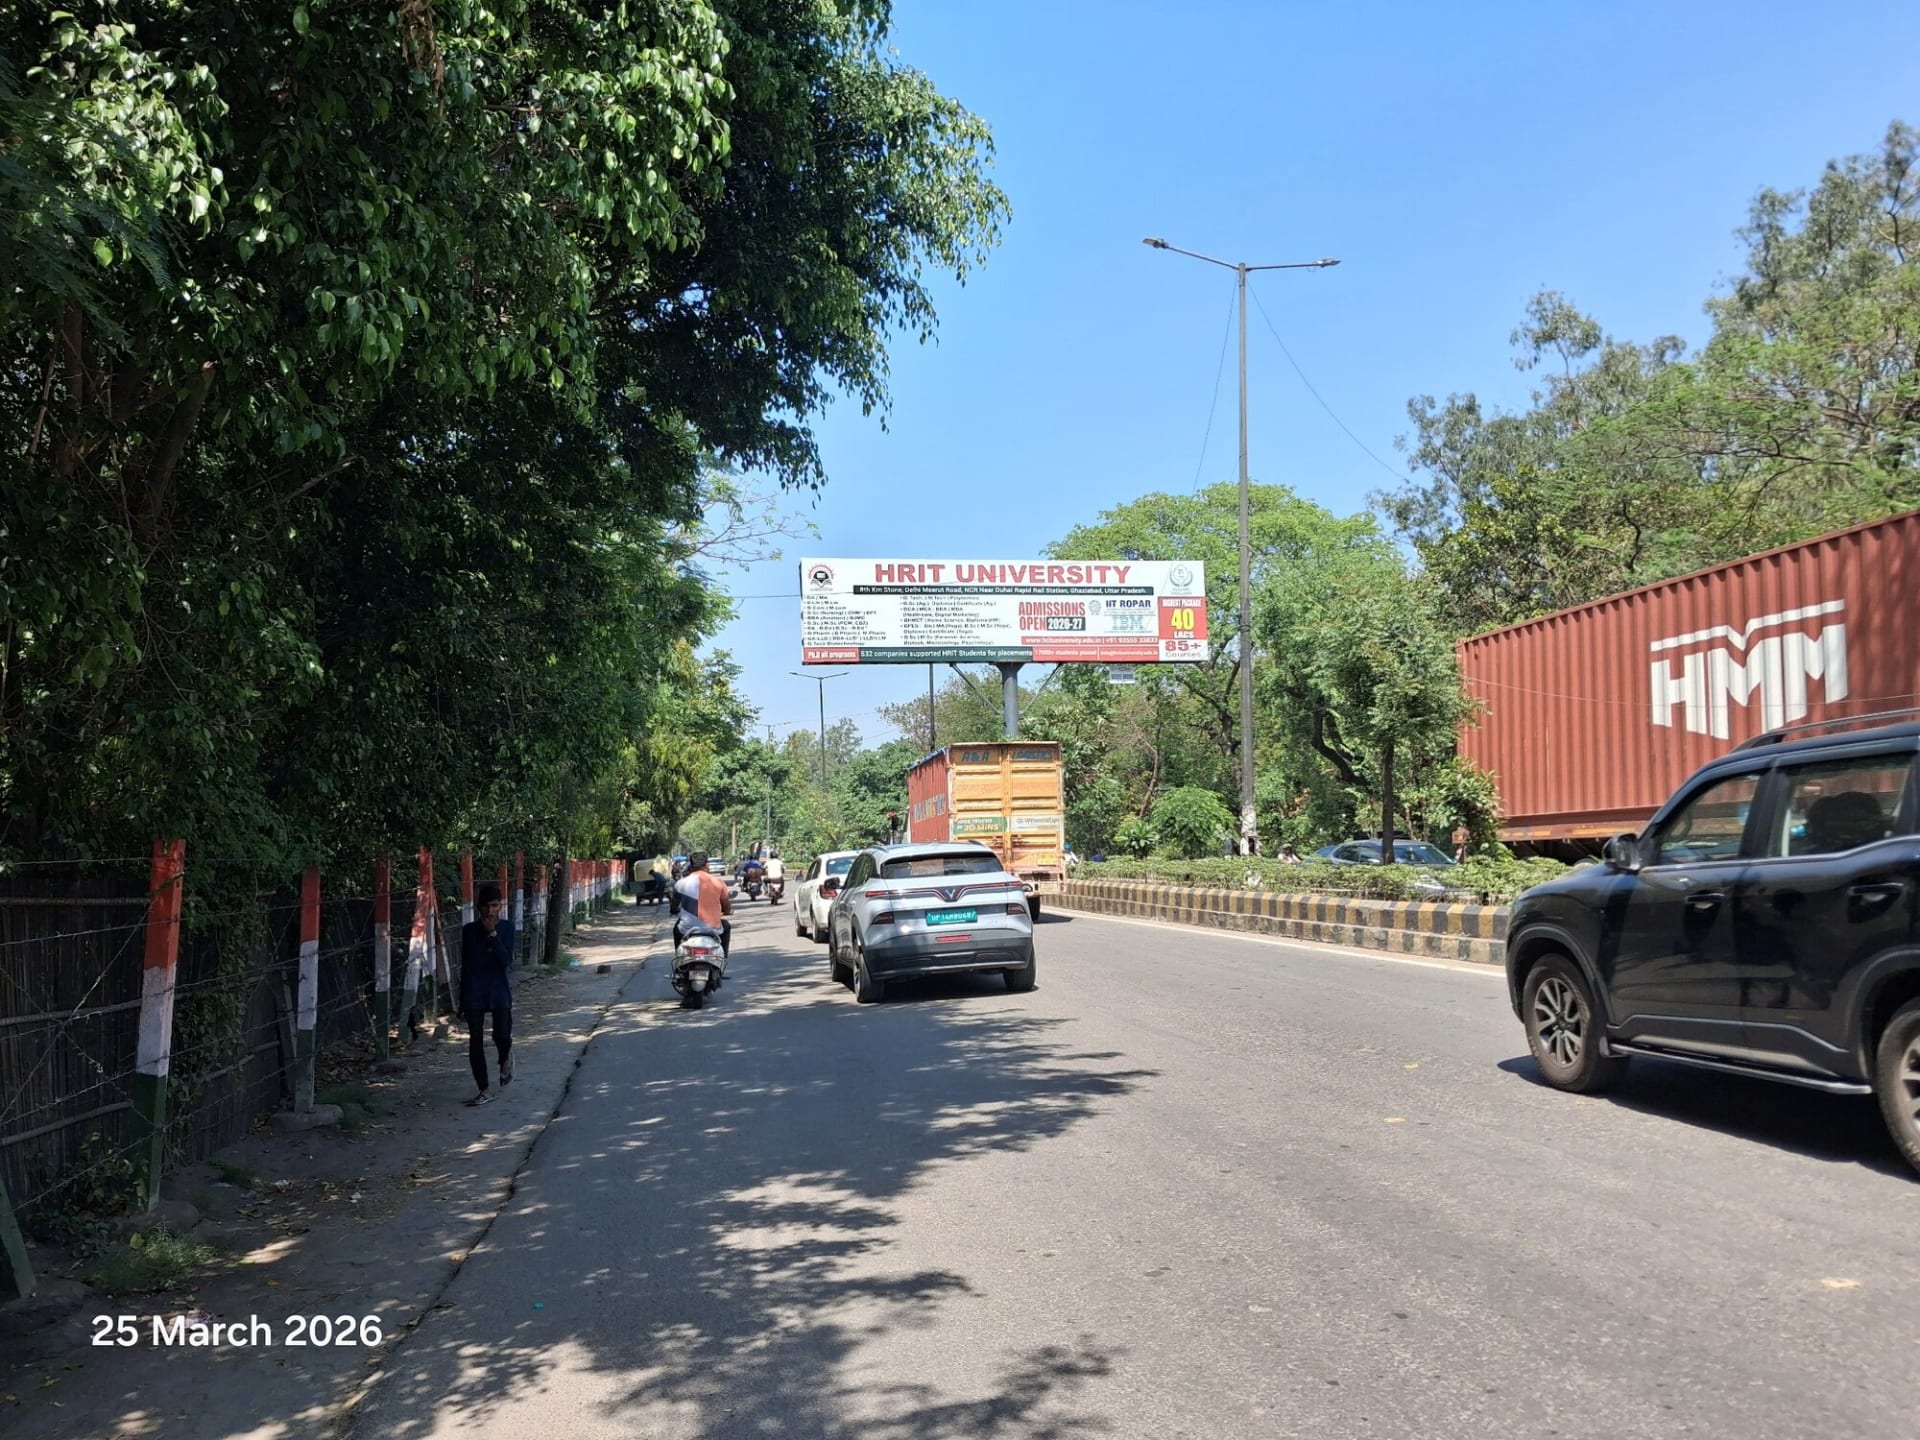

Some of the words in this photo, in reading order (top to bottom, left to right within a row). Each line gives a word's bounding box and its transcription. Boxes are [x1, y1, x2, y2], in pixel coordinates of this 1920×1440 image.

[875, 564, 945, 583] HRIT
[956, 564, 1131, 583] UNIVERSITY
[1018, 602, 1086, 616] ADMISSIONS
[1106, 600, 1117, 608] IIT
[1120, 600, 1151, 608] ROPAR
[1019, 616, 1047, 631] OPEN
[1047, 618, 1082, 630] 2026-27
[1112, 615, 1145, 631] IBM
[1171, 608, 1194, 631] 40
[1165, 641, 1201, 652] 85+
[874, 651, 908, 659] companies
[1651, 622, 1848, 740] HMM
